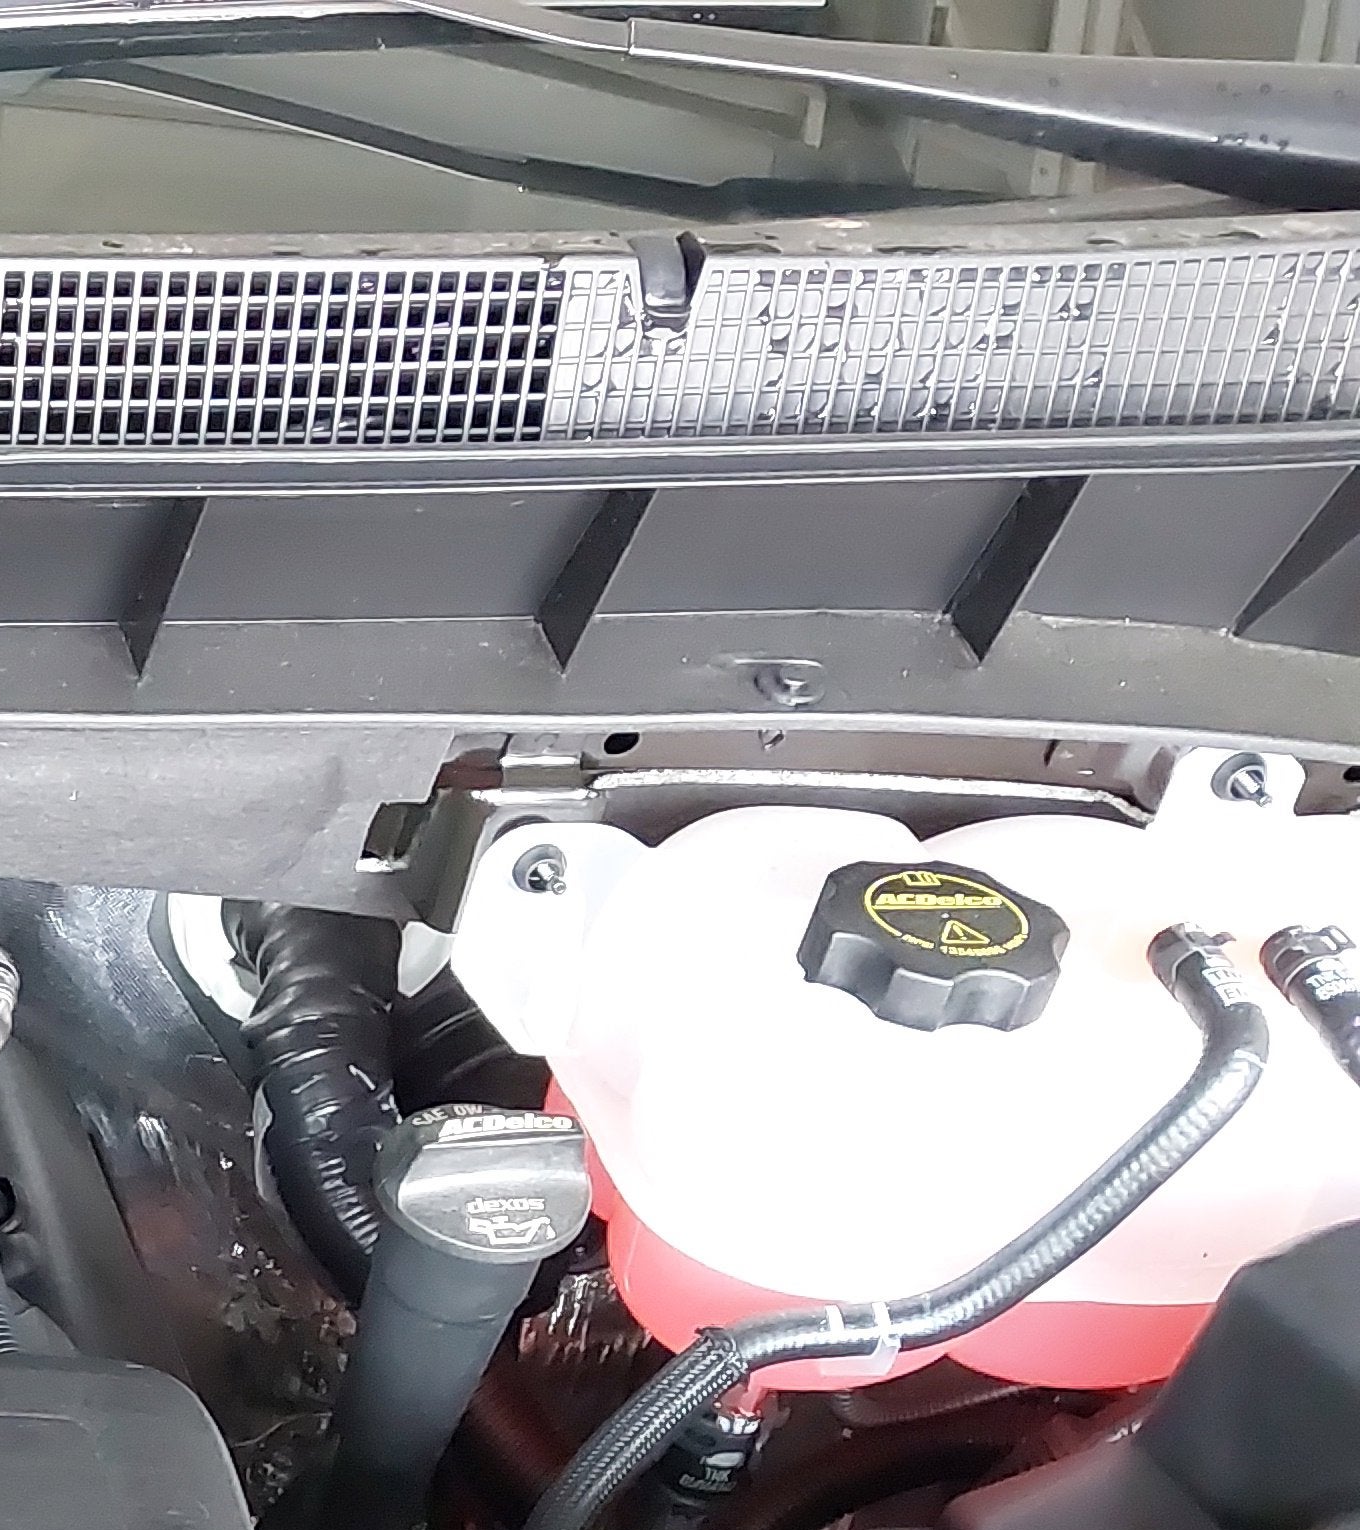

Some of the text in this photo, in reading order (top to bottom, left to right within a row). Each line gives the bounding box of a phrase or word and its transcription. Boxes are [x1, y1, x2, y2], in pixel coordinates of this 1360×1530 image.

[875, 892, 1003, 907] ACDelco
[412, 1107, 449, 1126] SAE
[439, 1113, 573, 1137] ACDelco
[466, 1197, 545, 1214] dexos
